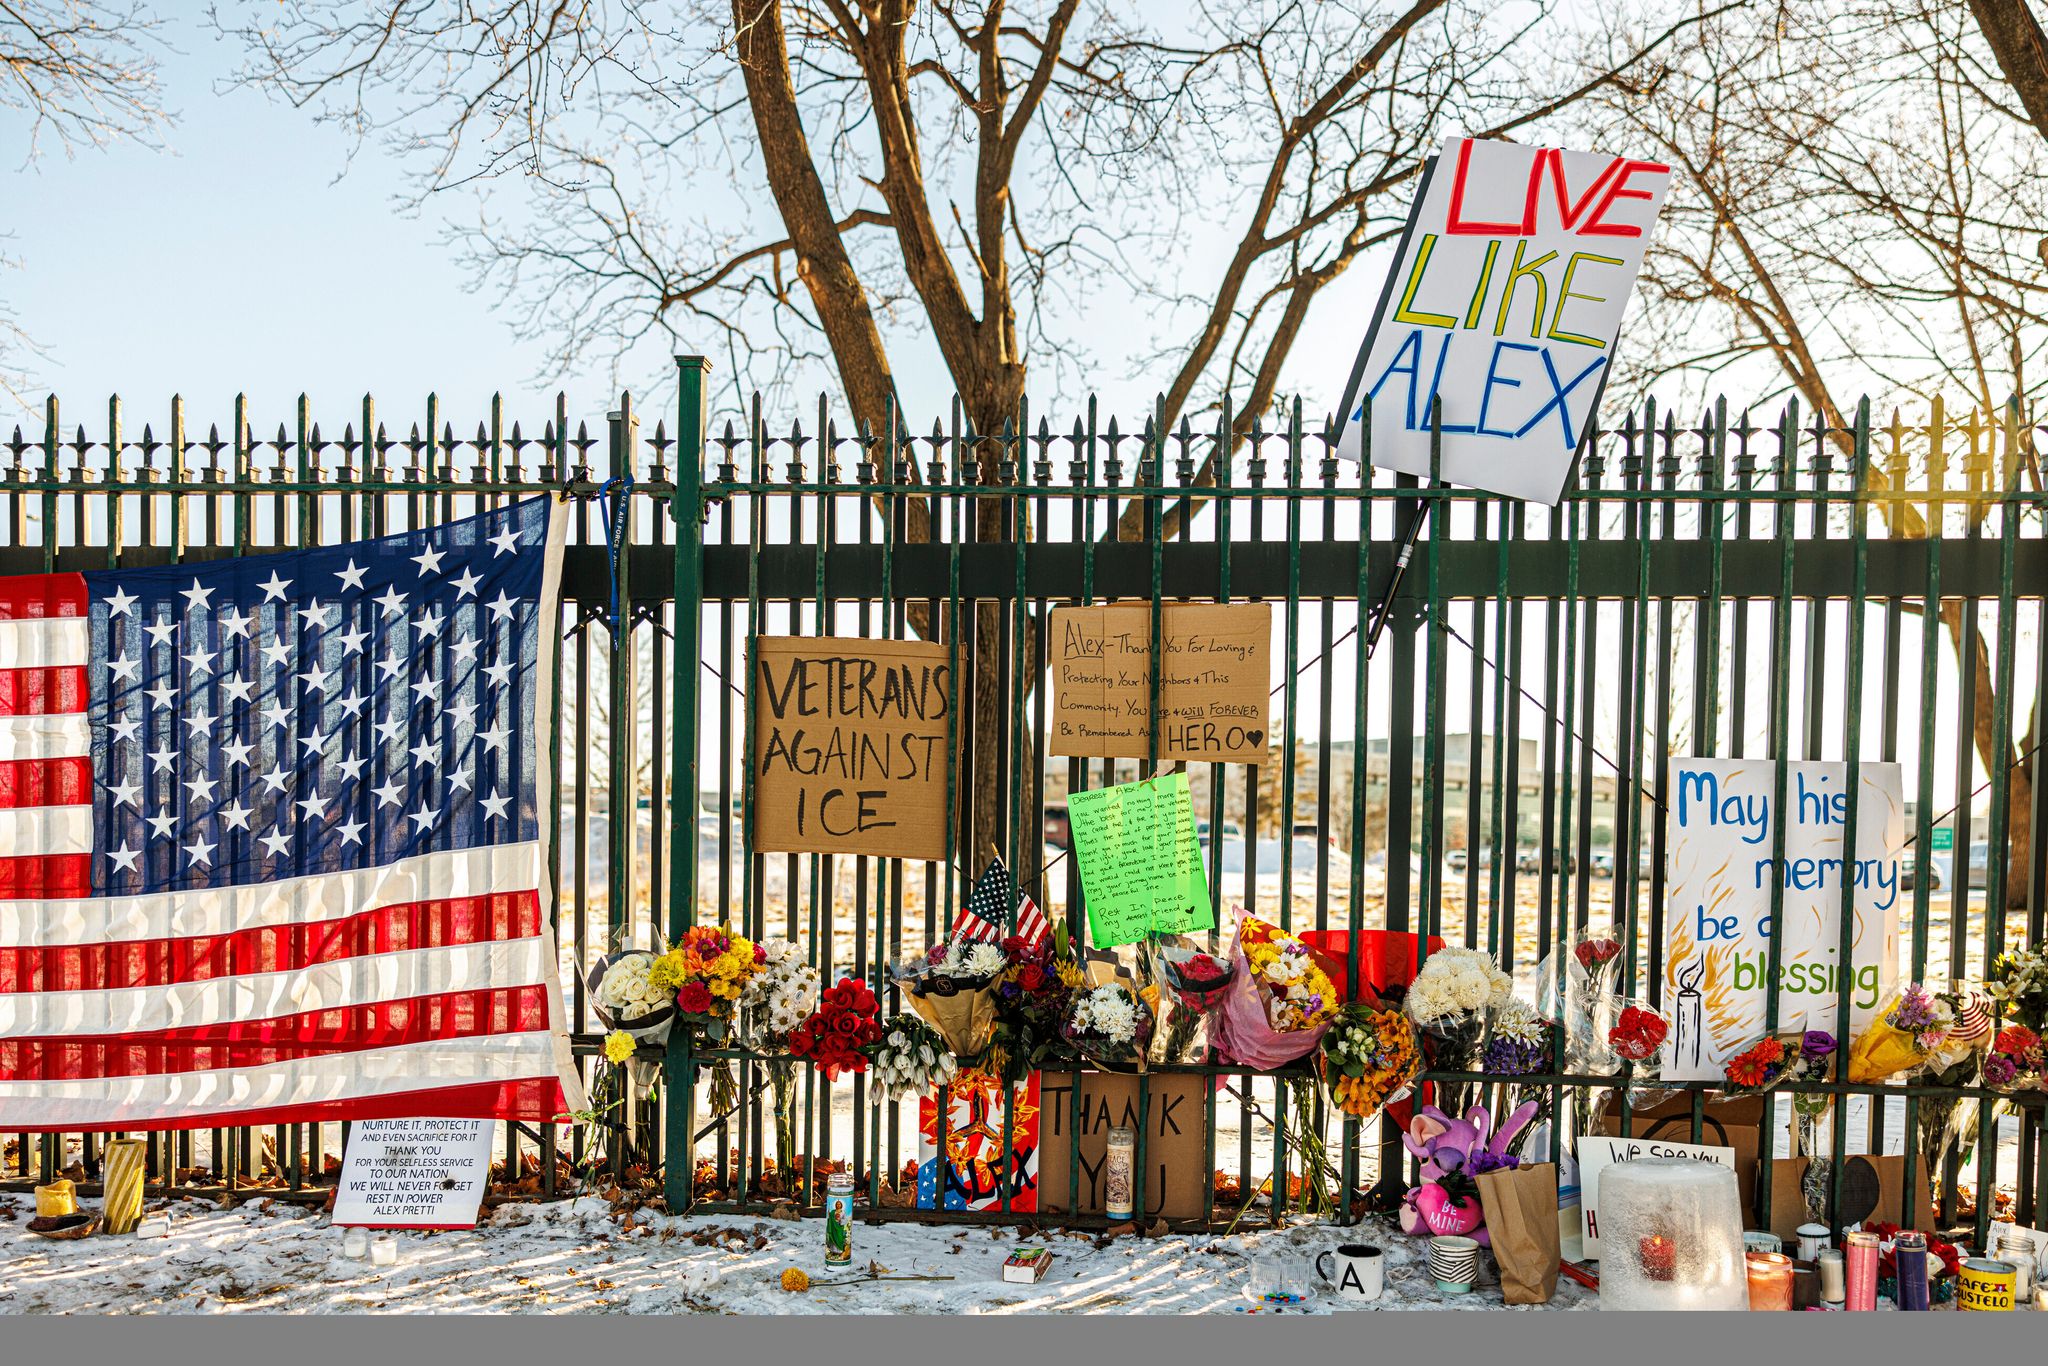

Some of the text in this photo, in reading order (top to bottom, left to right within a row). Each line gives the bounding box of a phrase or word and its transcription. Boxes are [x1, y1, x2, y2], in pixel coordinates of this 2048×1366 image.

[1446, 138, 1670, 238] LIVE
[1393, 234, 1625, 349] LIKE
[1351, 330, 1607, 450] ALEX
[614, 525, 622, 548] FORCE
[1164, 636, 1182, 653] You
[1188, 635, 1204, 653] For
[1209, 638, 1245, 661] Loving
[761, 657, 950, 721] VETERANS
[1063, 665, 1113, 689] Protecting
[1118, 671, 1139, 686] Your
[1142, 671, 1191, 692] Nghbors
[1202, 670, 1229, 685] This
[1060, 692, 1121, 717] Community.
[1126, 699, 1147, 716] You
[1180, 706, 1204, 719] will
[1209, 701, 1259, 719] FOREVER
[1060, 722, 1074, 736] Be
[1079, 722, 1134, 738] Remembered
[1138, 727, 1151, 736] As
[1168, 722, 1245, 751] HERO
[762, 726, 944, 782] AGAINST
[798, 788, 897, 836] ICE
[1094, 803, 1121, 814] wanted
[1679, 769, 1847, 844] May his
[1078, 848, 1098, 858] Thank
[1156, 832, 1172, 842] your
[1159, 840, 1172, 851] your
[1755, 858, 1898, 911] memory
[1098, 907, 1120, 920] Rest
[1129, 903, 1146, 912] In
[1104, 920, 1120, 929] my
[1151, 904, 1181, 916] friend
[1697, 904, 1740, 942] be
[1110, 926, 1148, 942] ALEX
[1734, 948, 1879, 1010] blessing
[1040, 1087, 1185, 1136] THANK
[361, 1134, 478, 1142] AND EVEN SACRIFICE FOR IT
[362, 1120, 480, 1131] NURTURE IT, PROTECT IT
[356, 1158, 474, 1166] FOR YOUR SELFLESS SERVICE
[384, 1146, 442, 1156] THANK YOU
[1610, 1142, 1641, 1163] We
[350, 1181, 473, 1191] WE WILL NEVER FOGET
[370, 1169, 448, 1178] TO OUR NATION
[944, 1146, 1036, 1204] ALEX
[1078, 1150, 1166, 1214] YU
[366, 1194, 443, 1204] REST IN POWER
[373, 1206, 434, 1215] ALEX PRETTI
[1442, 1200, 1456, 1216] BE
[1428, 1212, 1466, 1232] MINE
[1340, 1262, 1366, 1294] A
